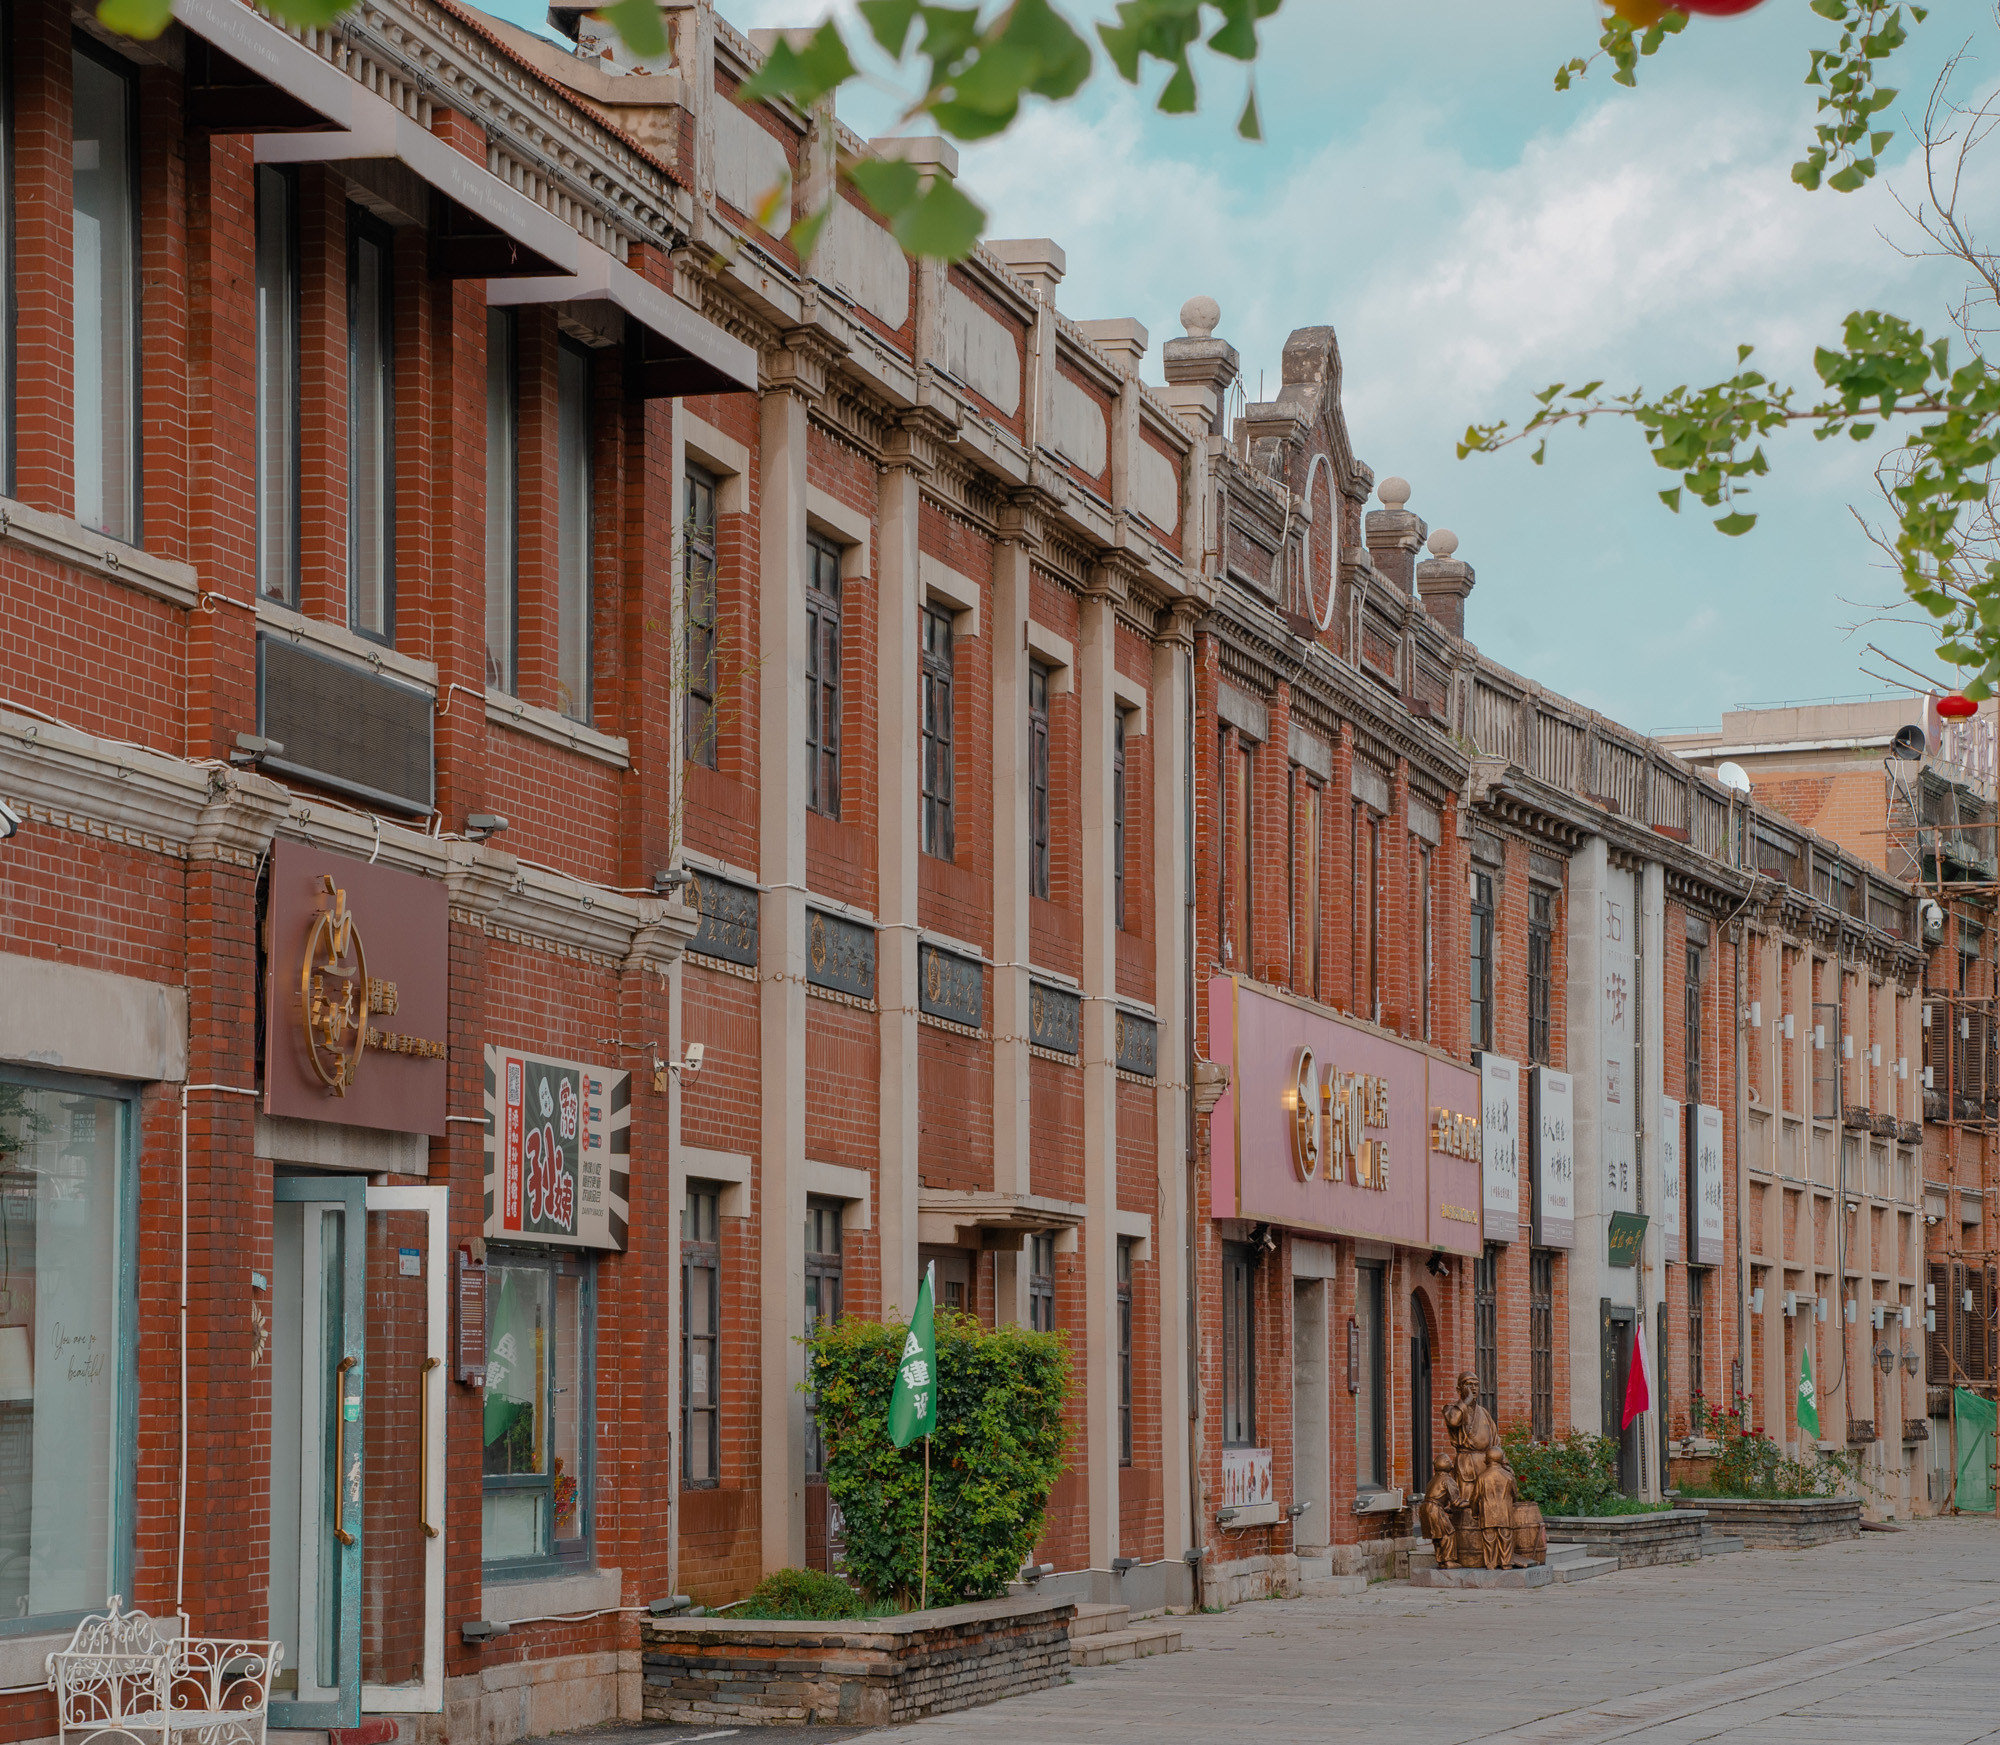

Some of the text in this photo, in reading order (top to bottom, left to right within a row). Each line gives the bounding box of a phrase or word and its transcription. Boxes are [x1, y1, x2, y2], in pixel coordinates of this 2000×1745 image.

[367, 977, 399, 1015] 摄影
[51, 1320, 72, 1360] You
[73, 1335, 87, 1347] are
[68, 1352, 105, 1385] beautiful
